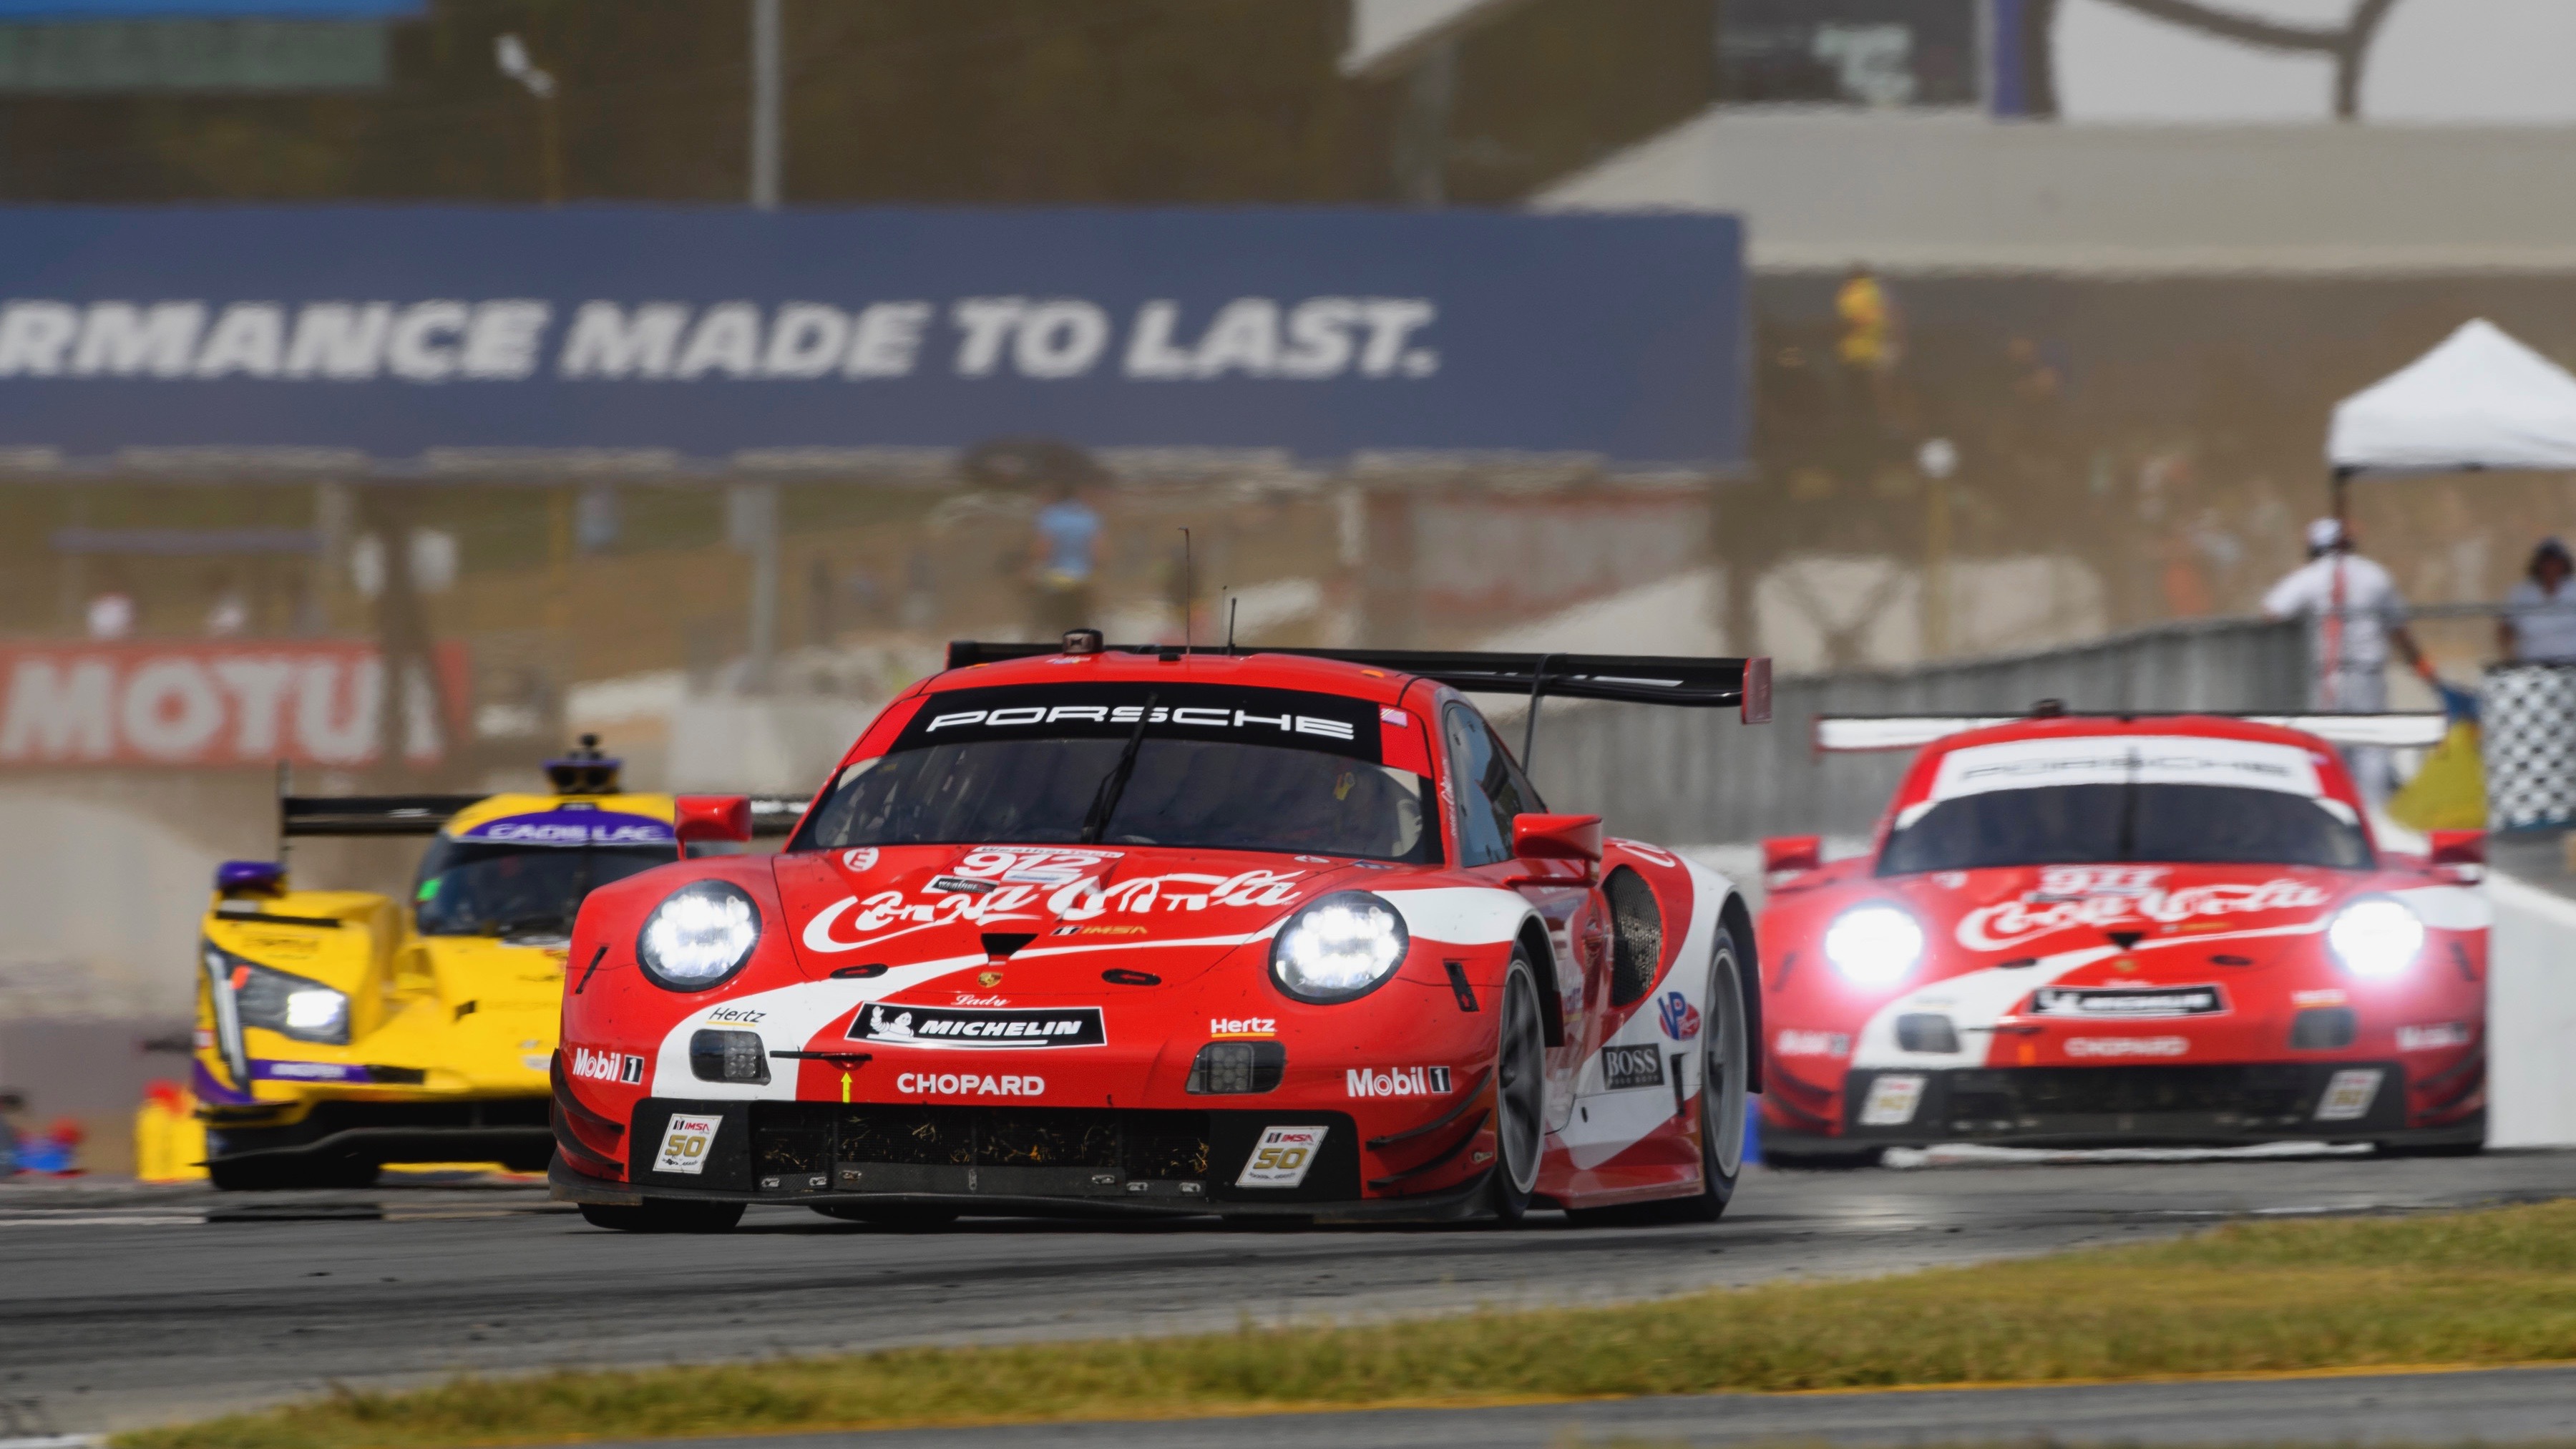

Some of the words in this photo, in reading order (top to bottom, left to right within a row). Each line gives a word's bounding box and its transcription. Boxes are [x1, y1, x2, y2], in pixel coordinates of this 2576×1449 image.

[0, 300, 547, 380] RMANCE
[562, 300, 931, 380] MADE
[954, 297, 1108, 379] TO
[1126, 297, 1438, 379] LAST.
[926, 706, 1354, 740] PORSCHE
[954, 852, 1101, 877] 912
[708, 1007, 767, 1023] Hertz
[1211, 1017, 1276, 1034] Hertz
[919, 1019, 1083, 1037] MICHELIN
[572, 1048, 621, 1081] Mobil
[1606, 1048, 1658, 1076] BOSS
[897, 1073, 1045, 1096] CHOPARD
[1347, 1066, 1427, 1097] Mobil
[685, 1122, 710, 1131] IMSA
[665, 1135, 706, 1157] 50
[1281, 1133, 1314, 1143] IMSA
[1253, 1148, 1309, 1169] 50
